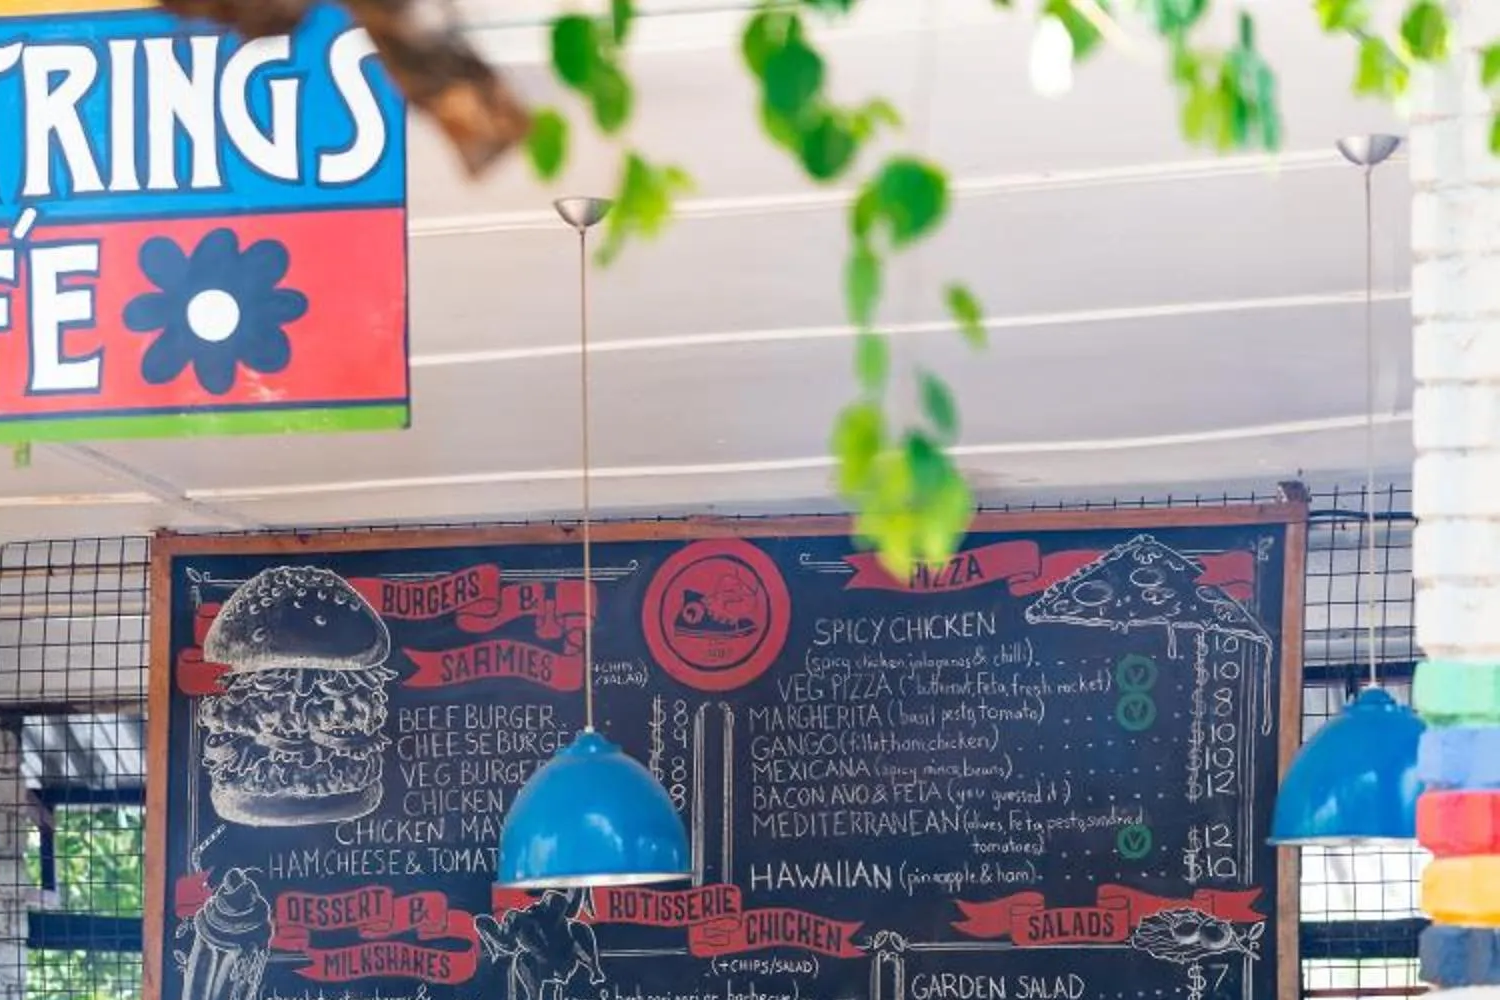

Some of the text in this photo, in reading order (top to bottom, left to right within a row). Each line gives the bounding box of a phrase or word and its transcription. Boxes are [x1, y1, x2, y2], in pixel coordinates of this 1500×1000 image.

[381, 571, 480, 616] BURGERS
[813, 611, 996, 645] SPICY CHICKEN
[440, 648, 552, 682] SARMIES
[777, 673, 824, 702] VEG
[831, 671, 893, 701] PIZZA
[398, 705, 460, 733] BEEF
[464, 702, 556, 731] BURGER
[749, 703, 883, 733] MARGHERITA
[396, 731, 492, 762] CHEESE
[496, 729, 571, 757] BURGE
[751, 732, 838, 761] GANGO
[399, 760, 451, 788] VEG
[752, 757, 871, 783] MEXICANA
[402, 787, 504, 817] CHICKEN
[893, 779, 942, 804] FETA
[335, 818, 445, 846] CHICKEN
[751, 808, 960, 838] MEDITERRANEAN
[404, 850, 424, 876] &
[427, 846, 499, 874] TOMAT
[750, 859, 893, 892] HAWAIIAN
[286, 889, 385, 927] DESSERT
[608, 887, 843, 952] ROTISSERIE CHICKEN
[1027, 911, 1115, 941] SALADS
[323, 945, 451, 979] MILKSHAKES
[911, 973, 1006, 1000] GARDEN
[1015, 973, 1086, 1000] SALAD
